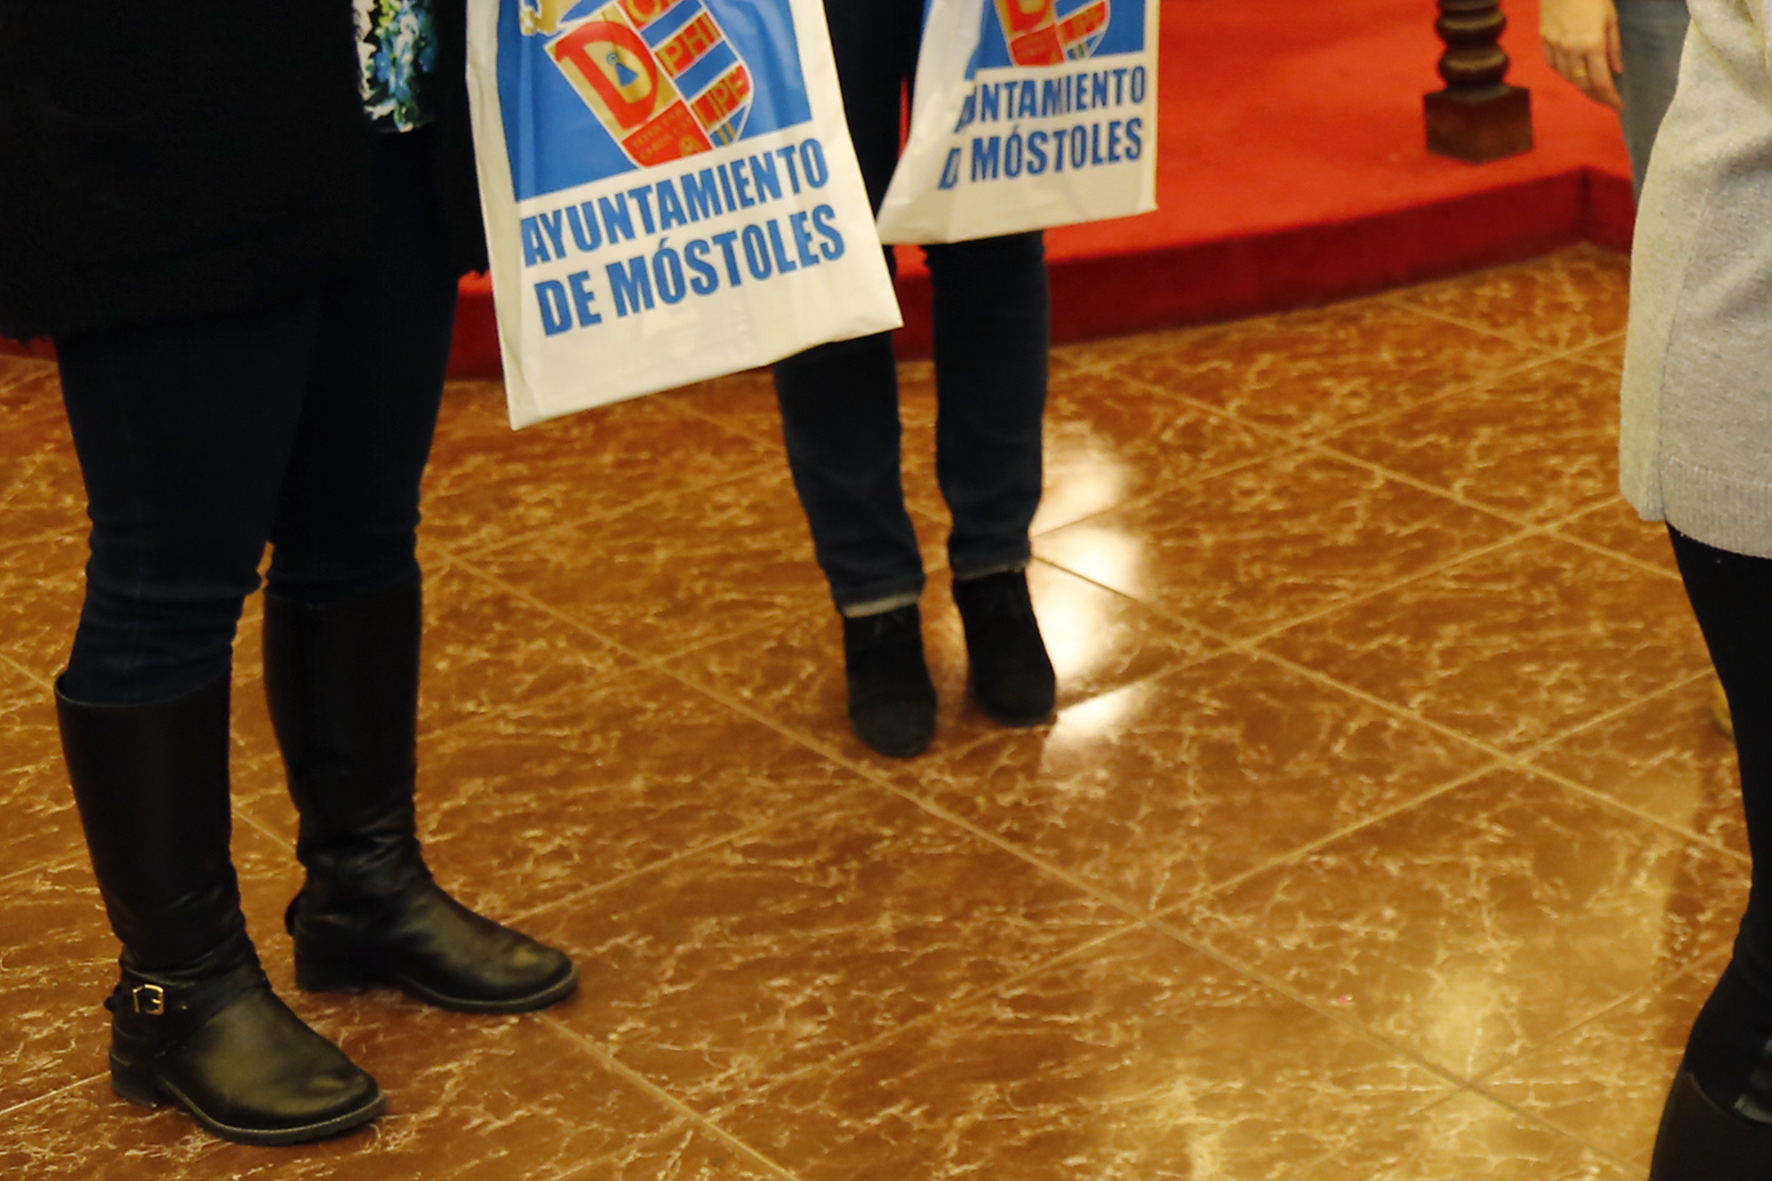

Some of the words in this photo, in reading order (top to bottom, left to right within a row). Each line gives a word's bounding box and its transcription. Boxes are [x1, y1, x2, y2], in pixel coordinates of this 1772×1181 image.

[554, 21, 659, 131] D
[653, 15, 722, 79] PHI
[520, 137, 829, 269] AYUNTAMIENTO
[971, 117, 1142, 183] MÓSTOLES
[533, 269, 603, 337] DE
[605, 203, 846, 319] MÓSTOLES
